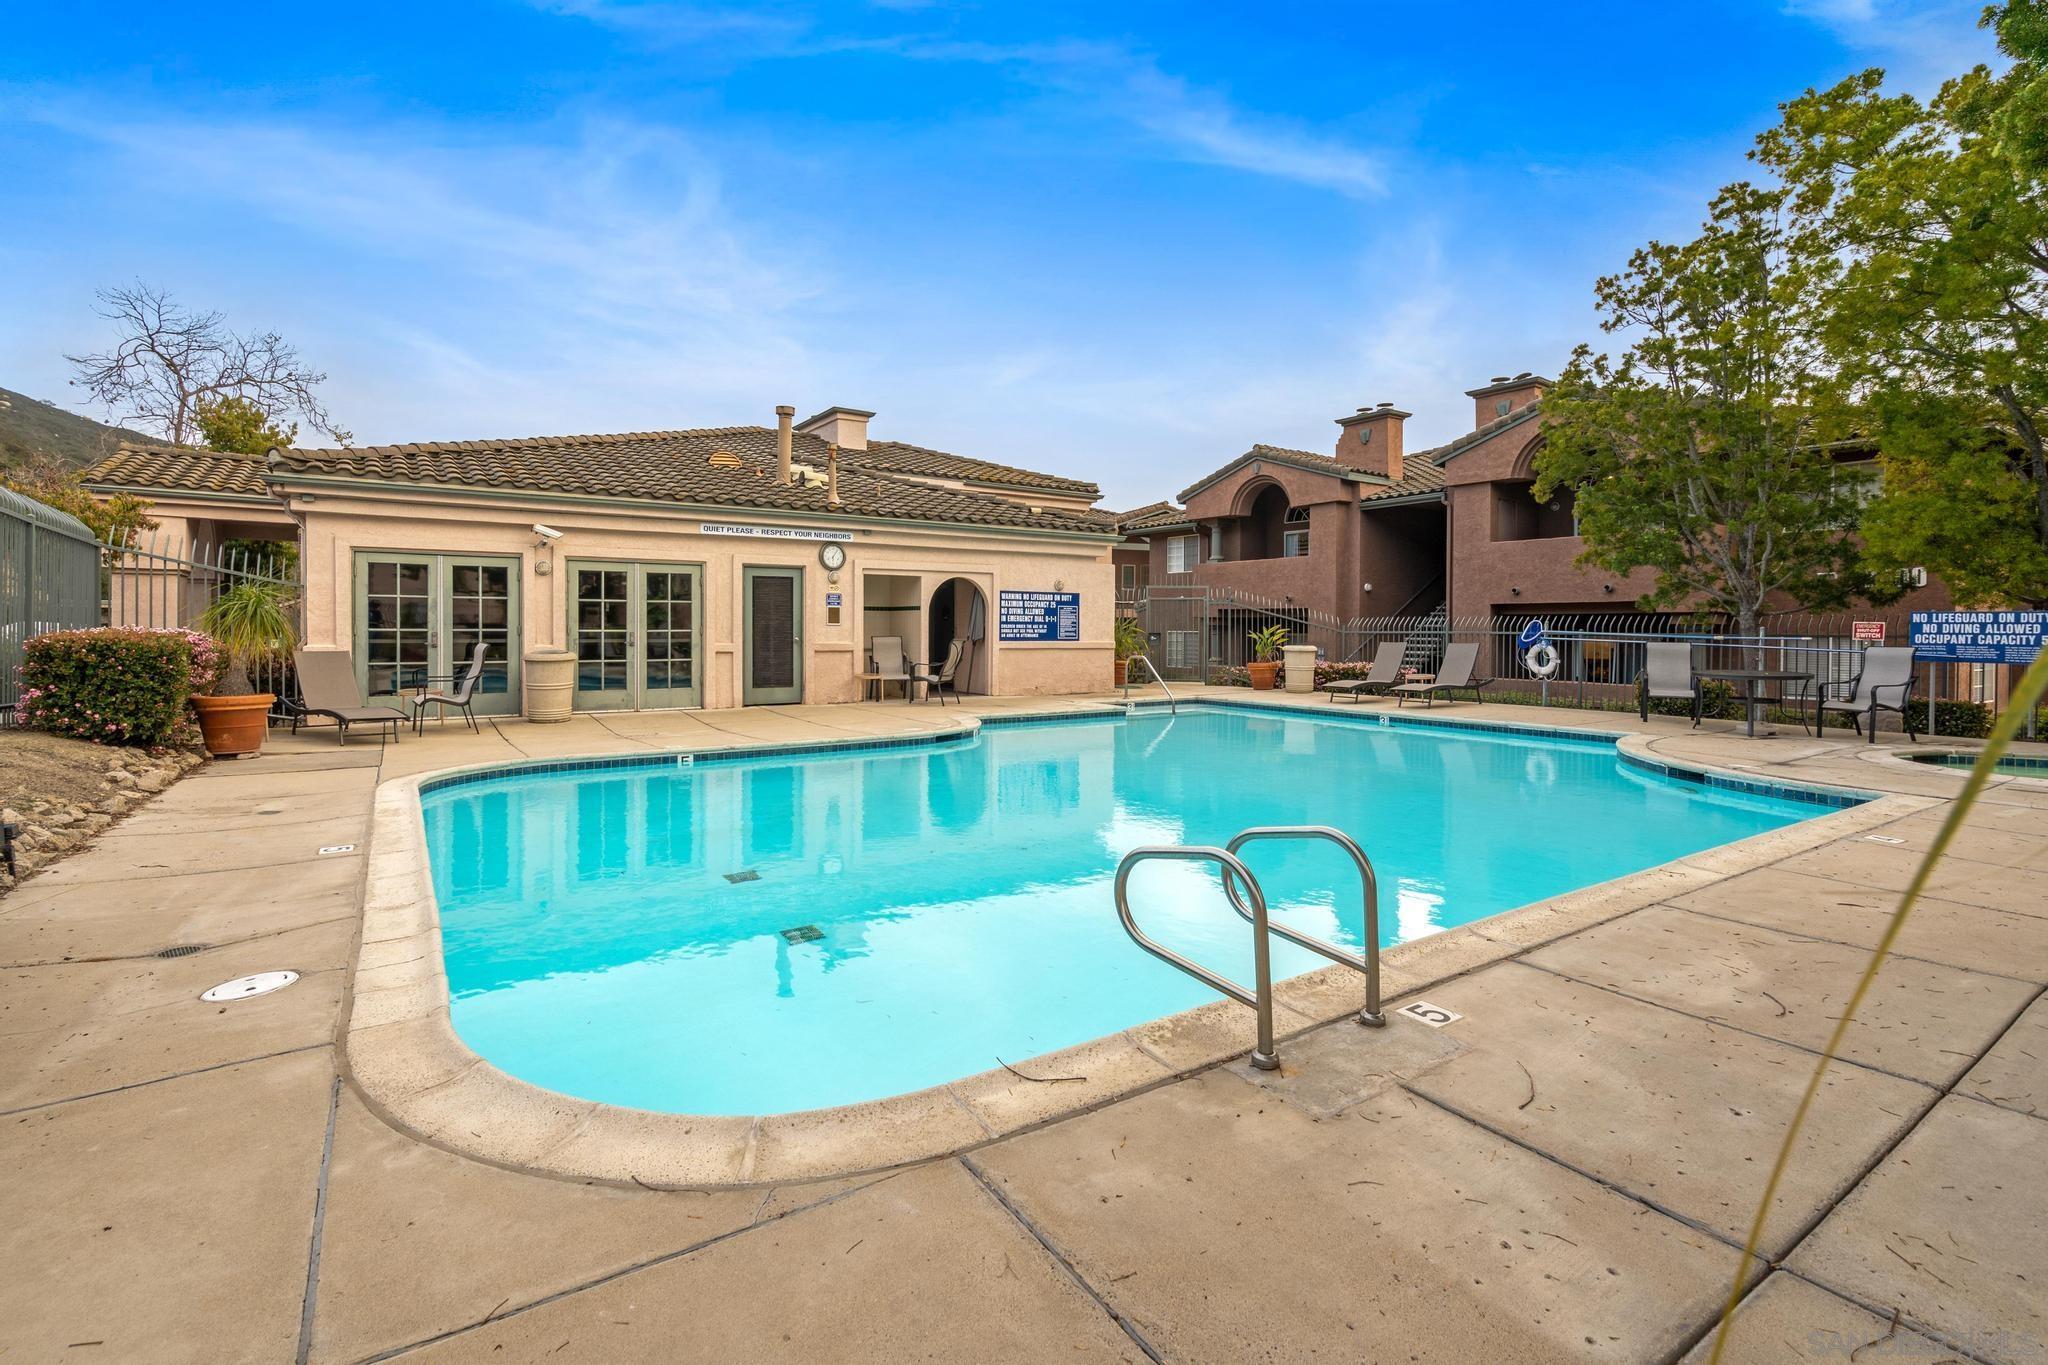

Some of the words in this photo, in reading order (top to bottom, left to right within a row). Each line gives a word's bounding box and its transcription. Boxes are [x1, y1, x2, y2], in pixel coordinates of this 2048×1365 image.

[762, 528, 792, 536] RESPECT
[1912, 613, 1928, 622] NO
[1932, 613, 1994, 622] LIFEGUARD
[1998, 613, 2015, 622] ON
[2020, 613, 2048, 623] DUTY
[1922, 624, 1937, 633] NO
[1942, 624, 1980, 634] DIVING
[1986, 624, 2041, 634] ALLOWED
[1914, 634, 1974, 644] OCCUPANT
[1978, 635, 2036, 645] CAPACITY
[1405, 1004, 1451, 1023] 5
